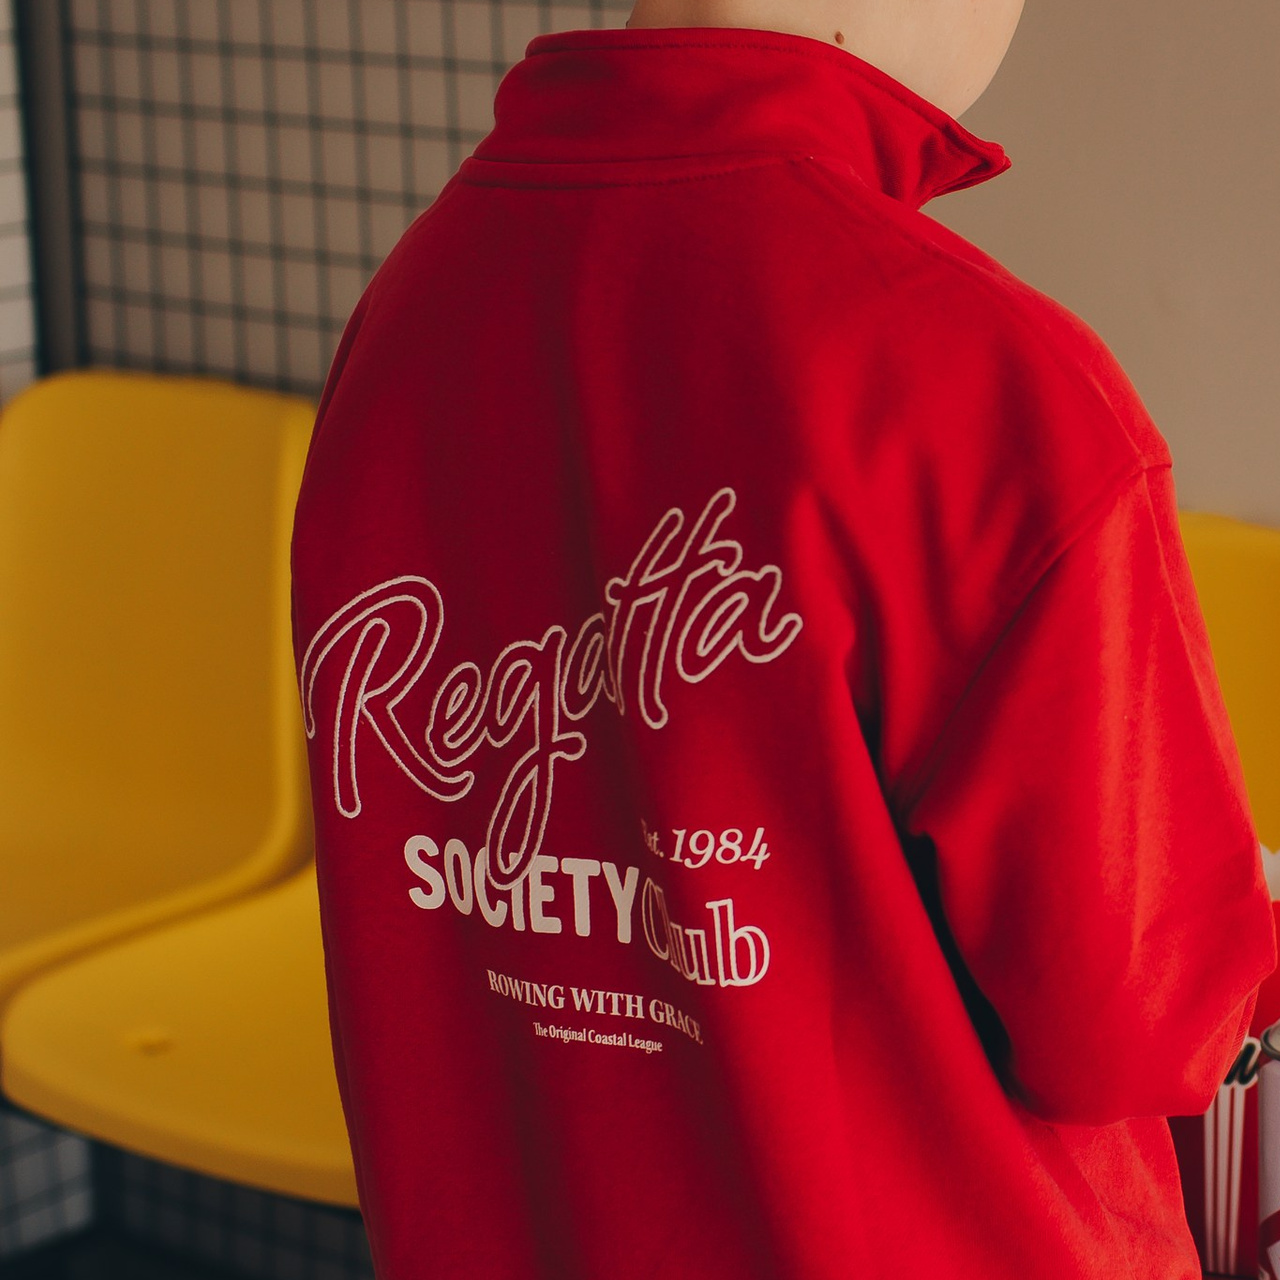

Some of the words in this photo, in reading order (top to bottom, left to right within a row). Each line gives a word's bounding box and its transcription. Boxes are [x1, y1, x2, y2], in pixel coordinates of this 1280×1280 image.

[301, 487, 803, 891] Regatta
[668, 826, 772, 871] 1984
[403, 834, 641, 945] SOCIETY
[486, 968, 566, 1010] ROWING
[569, 986, 646, 1020] WITH
[532, 1021, 549, 1038] The
[548, 1024, 588, 1044] Original
[587, 1028, 628, 1048] Coastal
[628, 1033, 664, 1055] League
